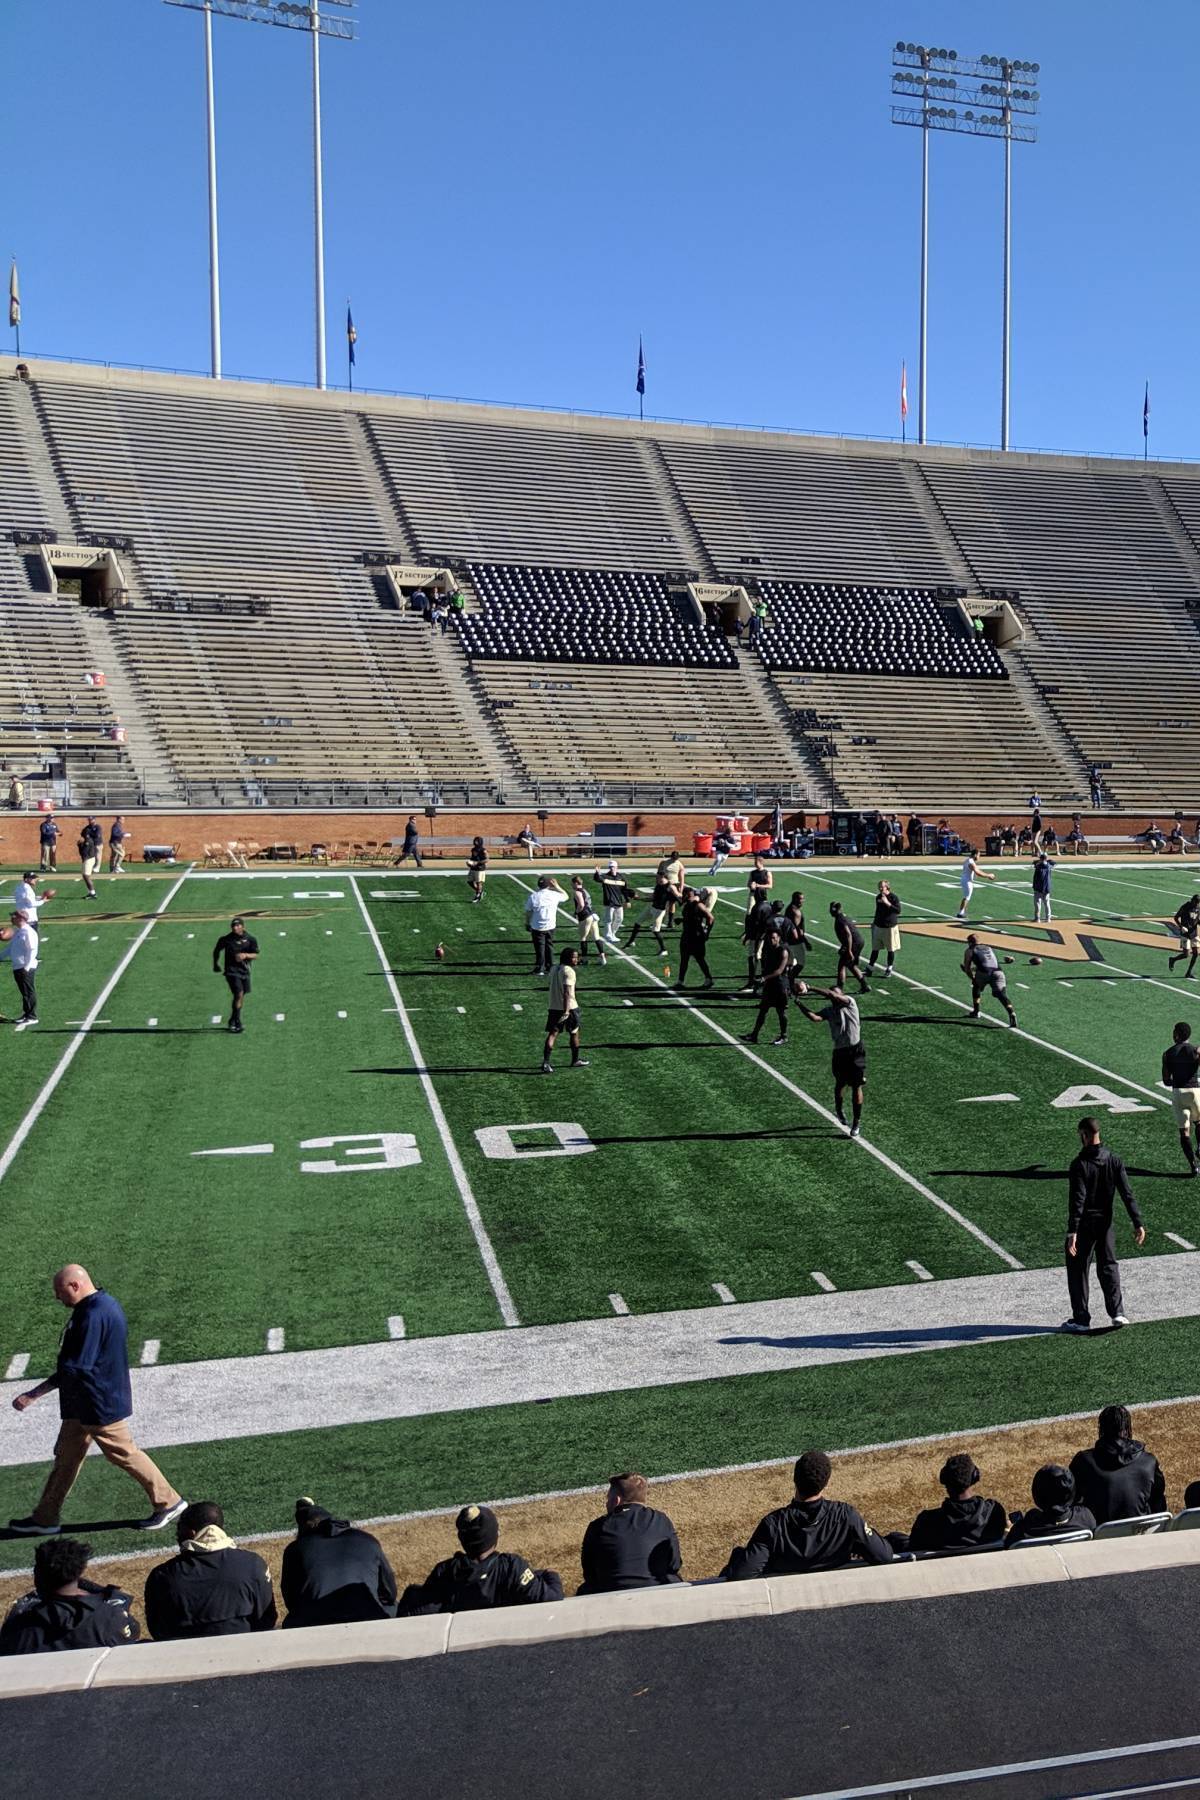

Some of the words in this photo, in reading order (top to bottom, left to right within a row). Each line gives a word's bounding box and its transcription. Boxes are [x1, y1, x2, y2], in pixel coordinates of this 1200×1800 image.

[49, 549, 62, 559] 18
[62, 552, 93, 560] SECTION
[96, 553, 107, 562] 17
[394, 570, 403, 579] 17
